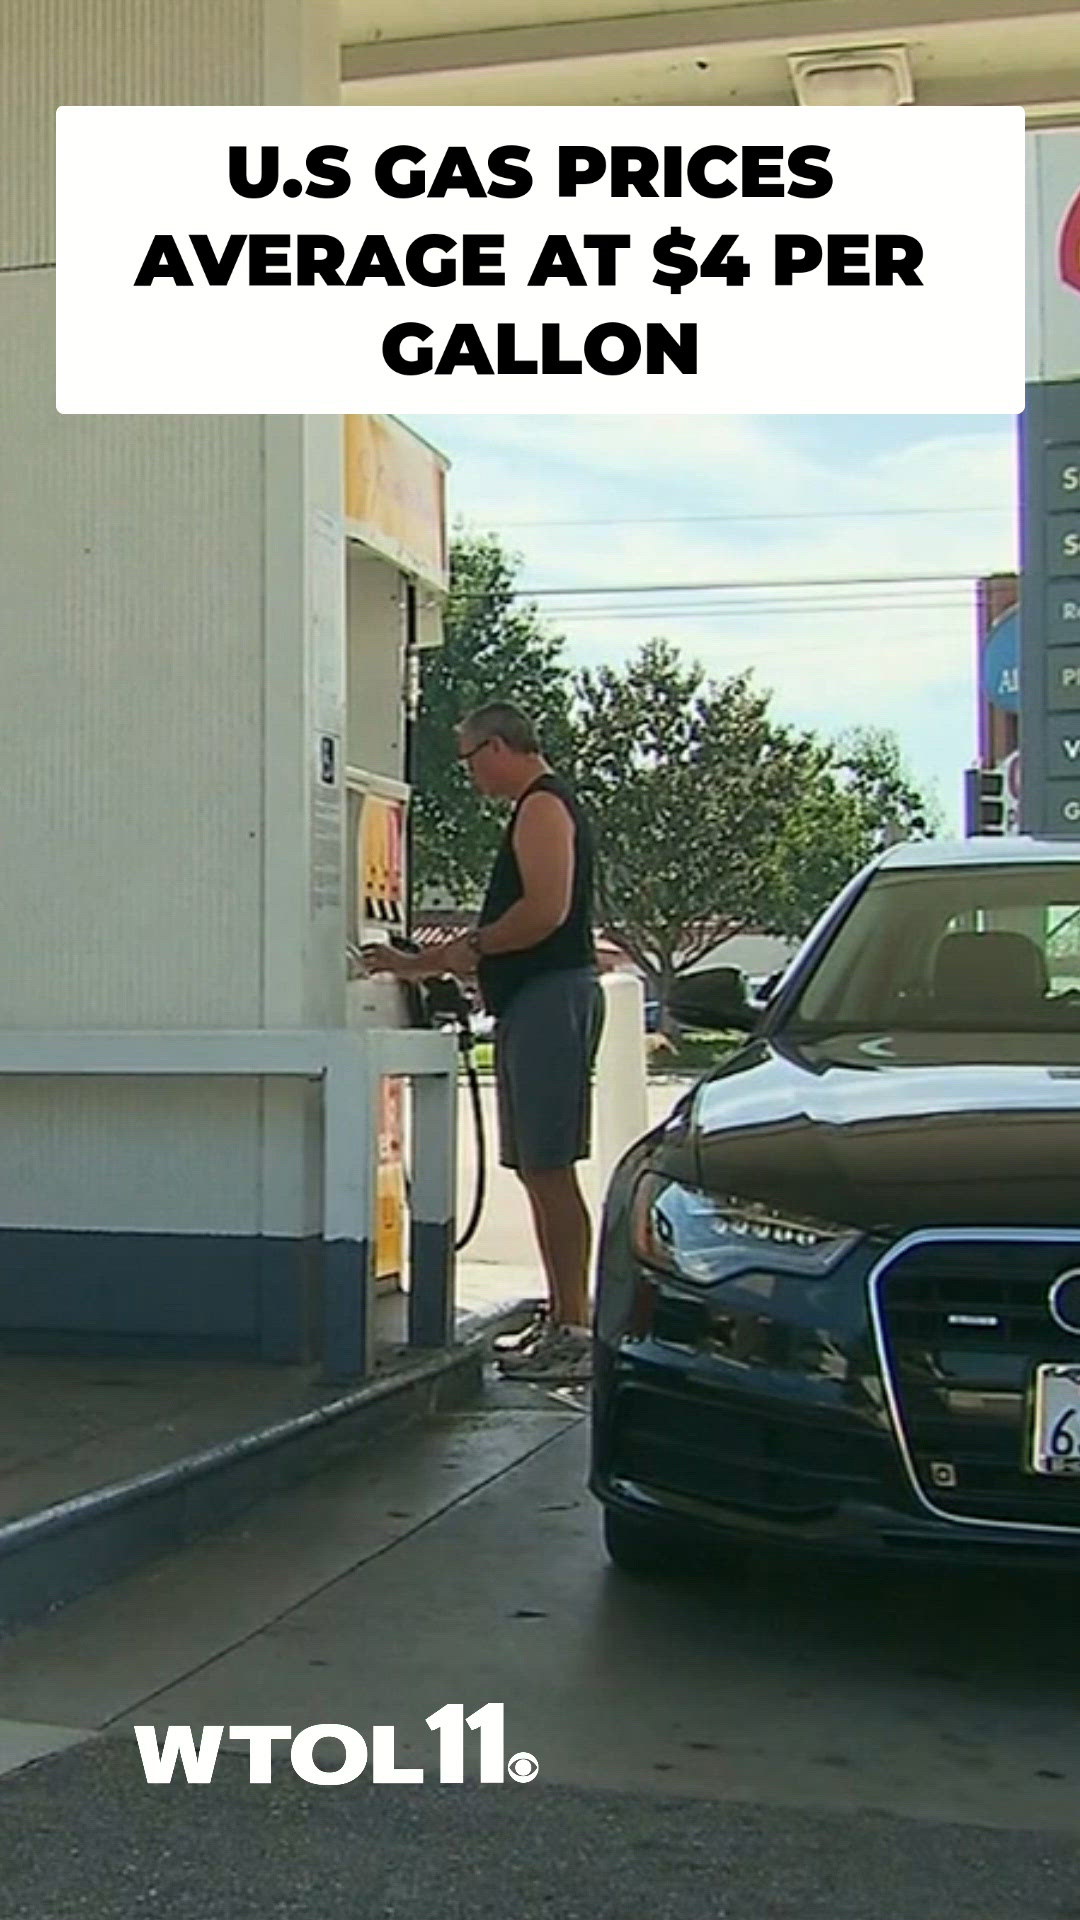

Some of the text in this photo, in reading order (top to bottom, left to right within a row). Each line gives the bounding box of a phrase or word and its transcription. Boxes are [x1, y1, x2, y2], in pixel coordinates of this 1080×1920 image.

[1062, 466, 1080, 490] S
[1063, 533, 1080, 556] S
[1051, 1408, 1080, 1456] 6
